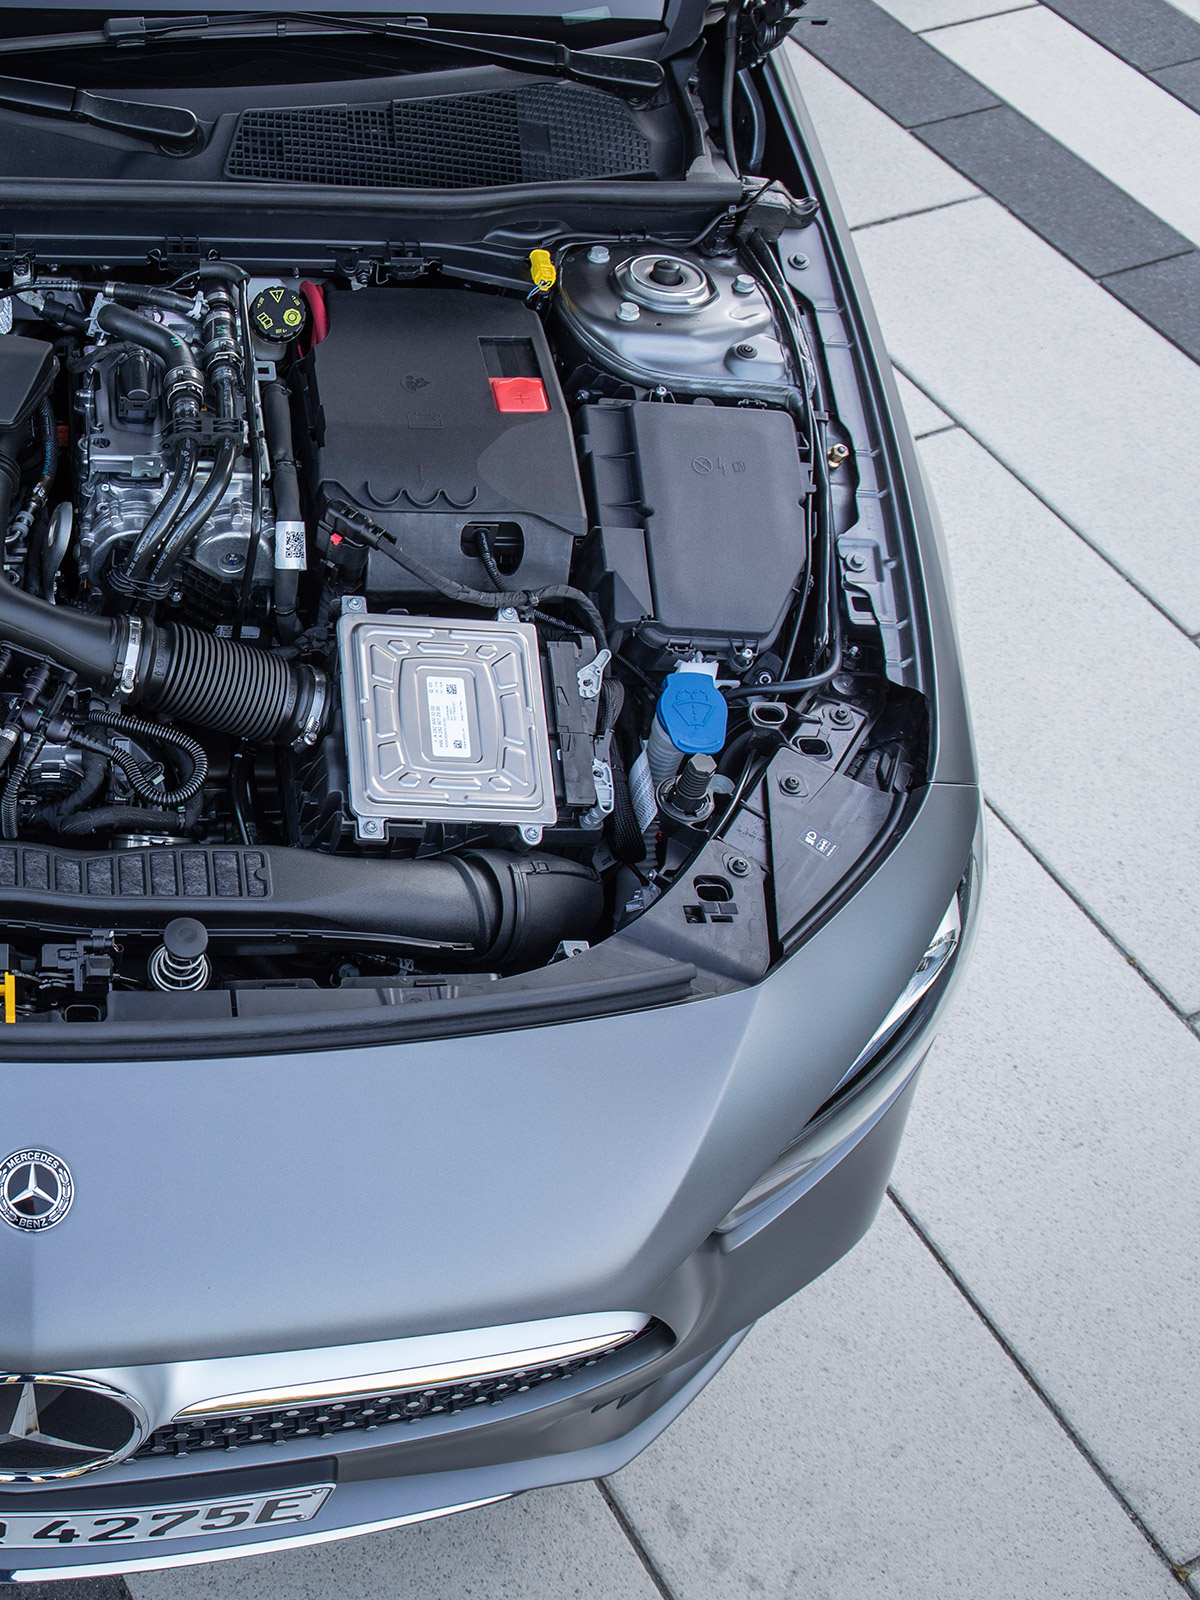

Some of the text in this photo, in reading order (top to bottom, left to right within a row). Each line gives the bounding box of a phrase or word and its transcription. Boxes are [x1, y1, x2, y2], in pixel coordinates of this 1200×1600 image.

[6, 1152, 59, 1169] MERCEDES
[19, 1218, 48, 1228] BENZ
[33, 1494, 313, 1543] 4275E
